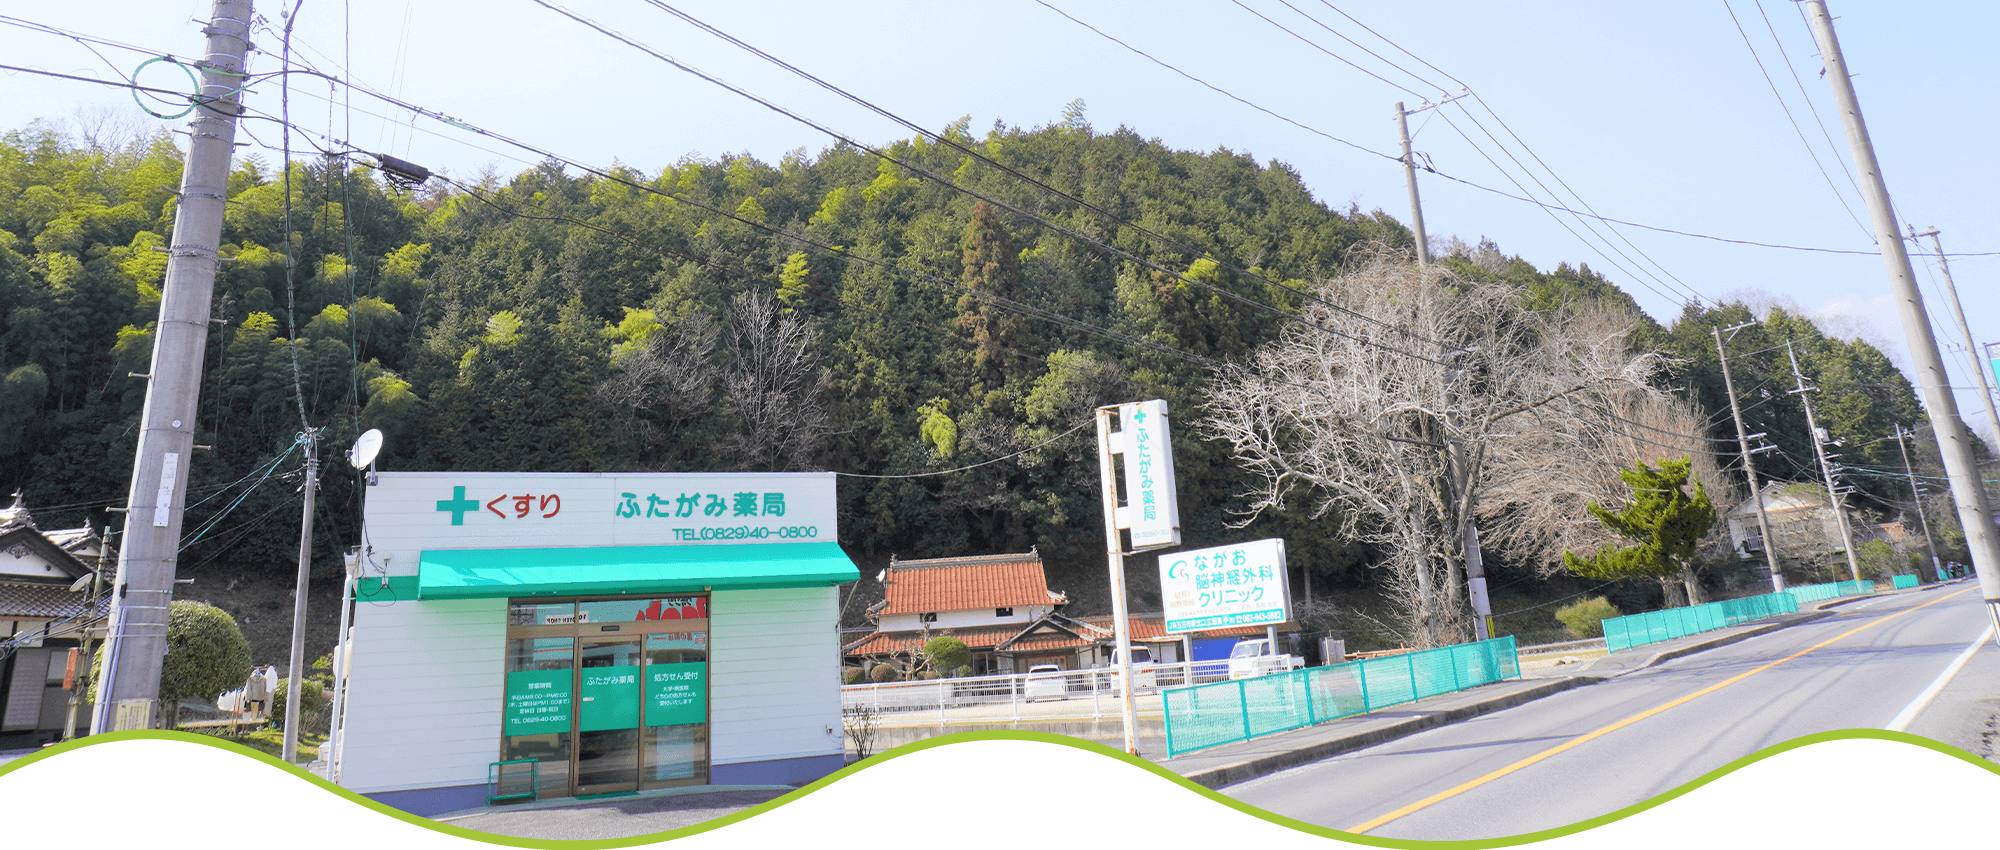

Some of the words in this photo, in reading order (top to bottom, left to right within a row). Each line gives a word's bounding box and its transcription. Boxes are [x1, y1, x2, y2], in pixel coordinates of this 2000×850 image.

[1136, 427, 1156, 521] ふたがみ薬局
[486, 493, 562, 518] くすり
[616, 491, 786, 518] ふたがみ薬局
[1194, 549, 1246, 571] ながお
[1195, 564, 1274, 591] 脳神経外科
[1198, 584, 1264, 608] クリニック
[586, 675, 635, 686] ふたがみ薬局
[654, 671, 698, 682] 処方せん受付
[659, 698, 692, 706] 受付いたします
